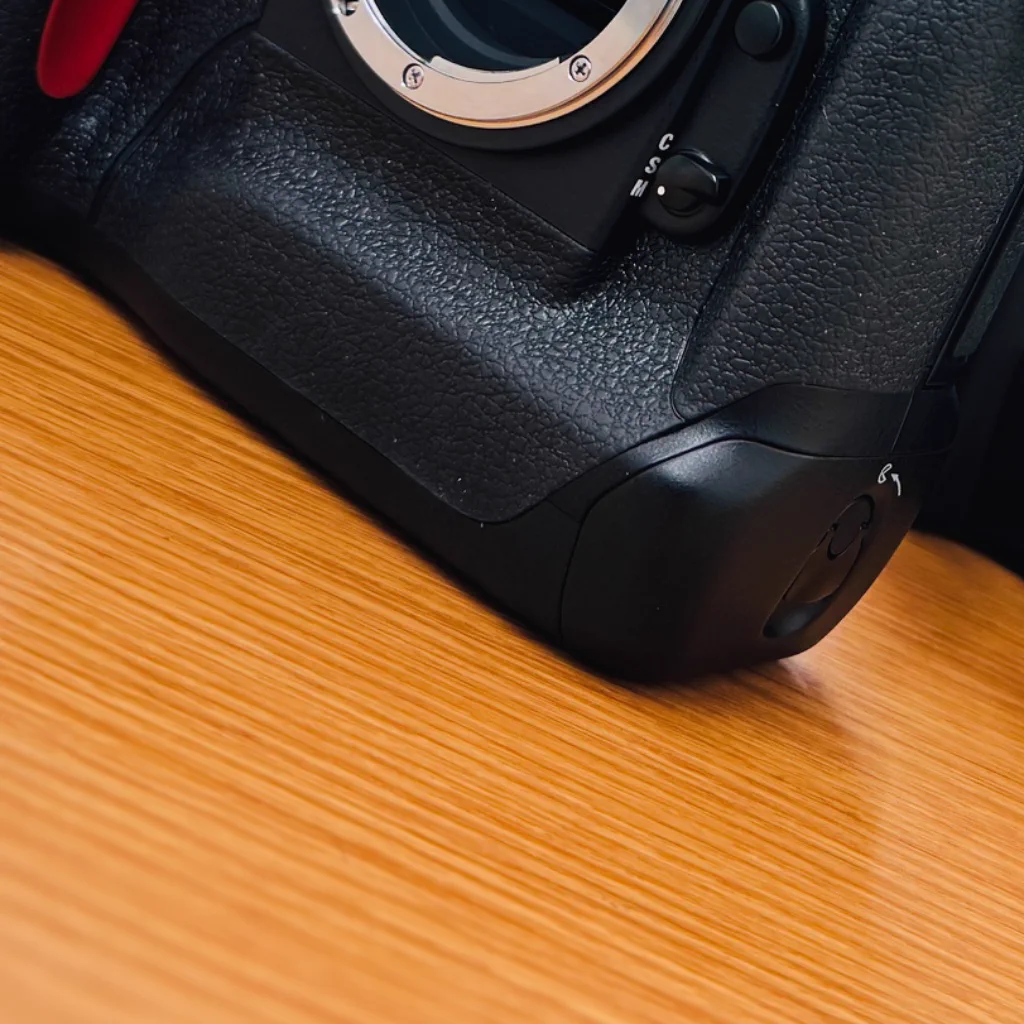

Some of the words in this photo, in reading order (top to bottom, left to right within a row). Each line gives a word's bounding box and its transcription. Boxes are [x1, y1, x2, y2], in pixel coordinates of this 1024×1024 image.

[658, 133, 673, 150] C
[645, 157, 661, 174] S
[630, 179, 648, 197] M
